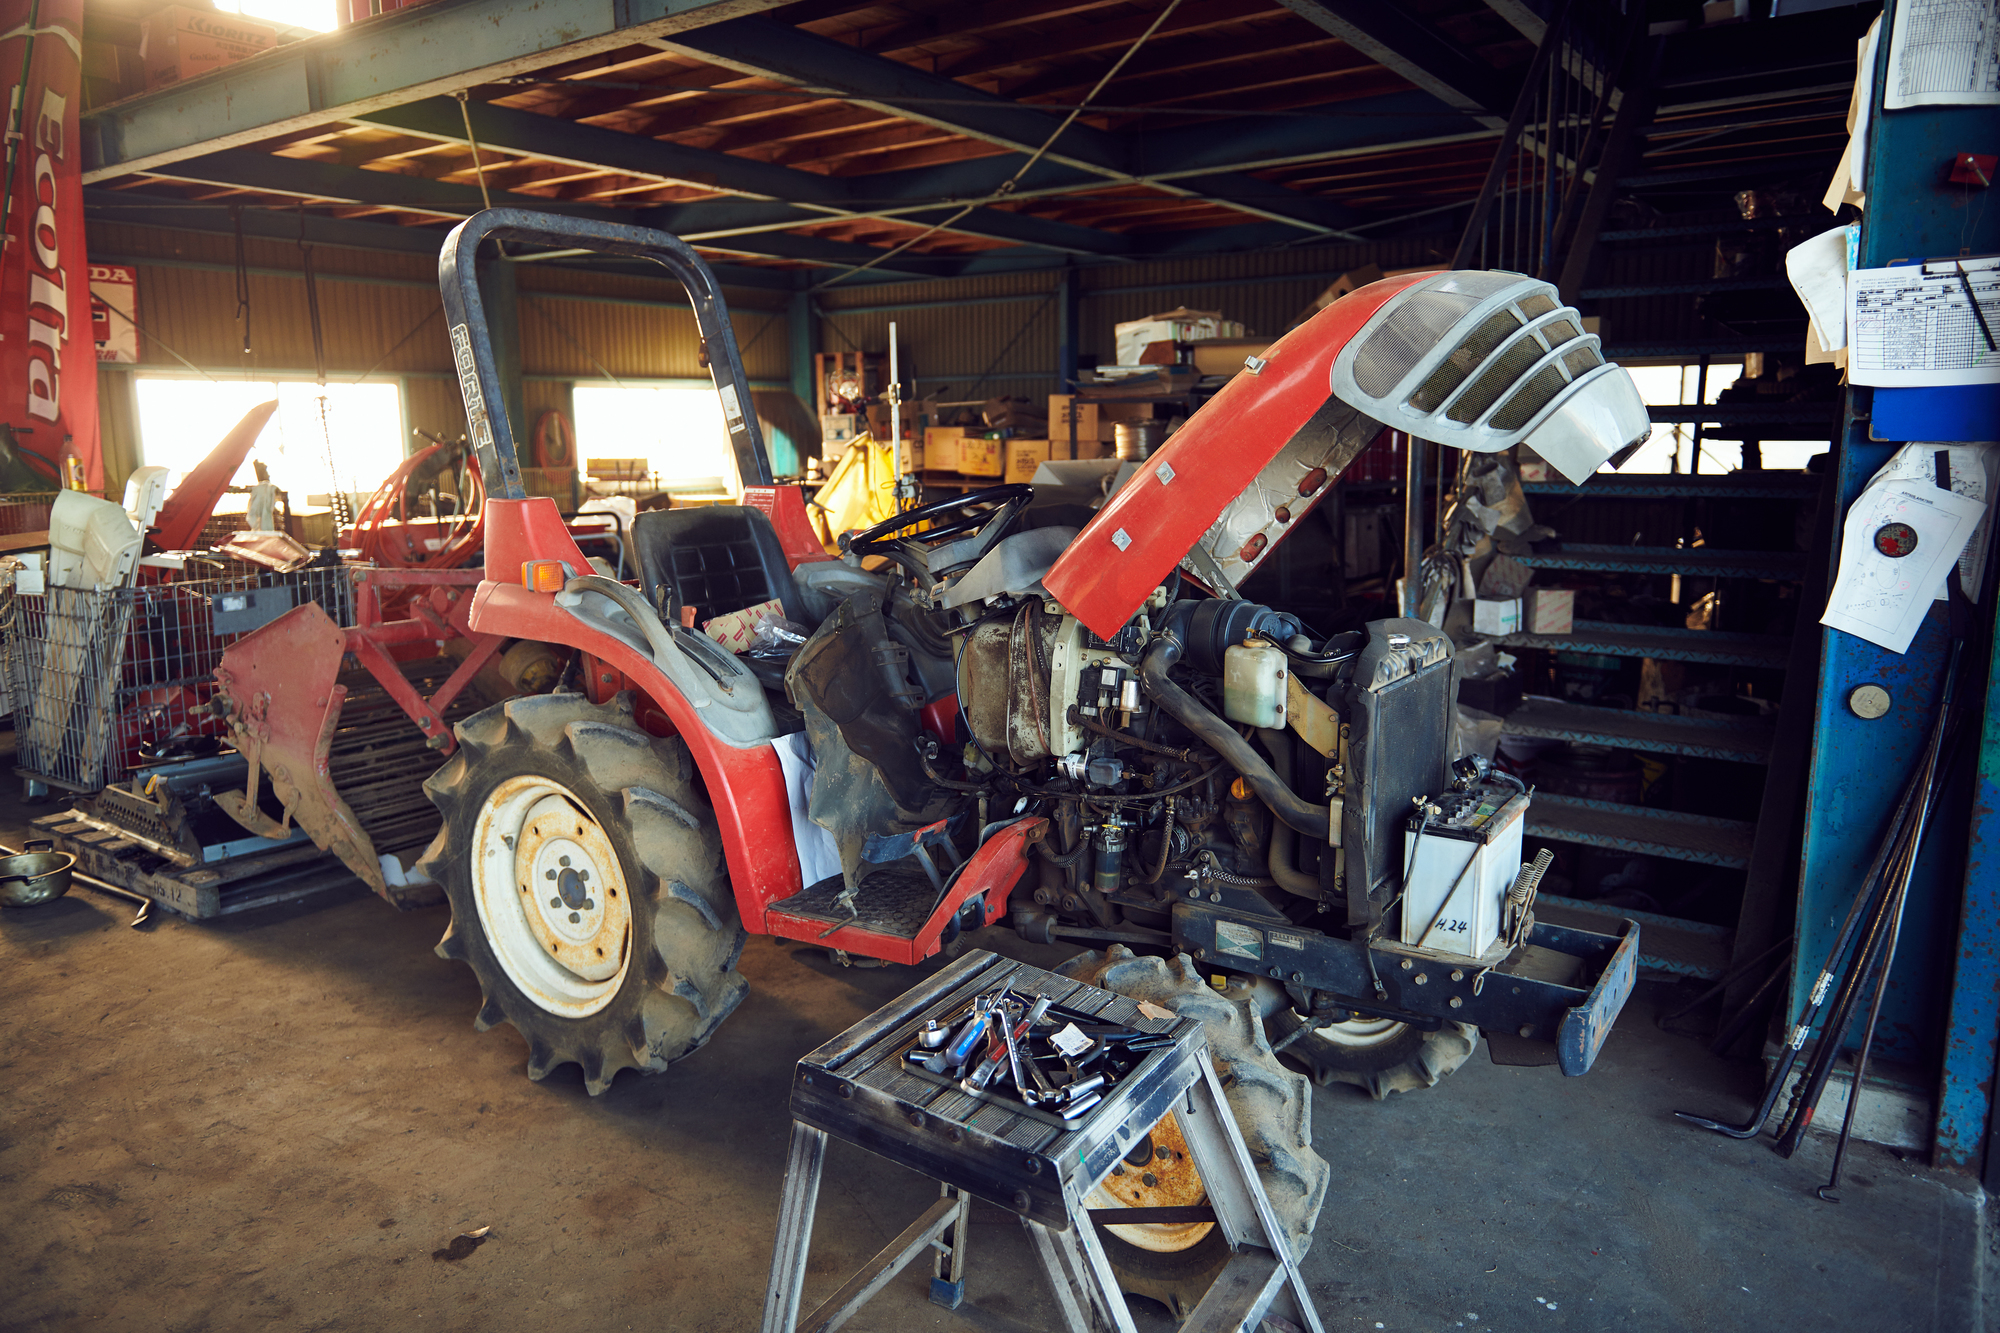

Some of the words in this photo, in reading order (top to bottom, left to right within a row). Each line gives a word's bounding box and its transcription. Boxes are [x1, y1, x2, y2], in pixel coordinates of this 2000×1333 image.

[187, 15, 266, 45] KIORITZ
[28, 87, 67, 425] EcoTra
[89, 267, 133, 282] DA
[451, 323, 492, 449] FORTE
[1435, 918, 1467, 934] H.24
